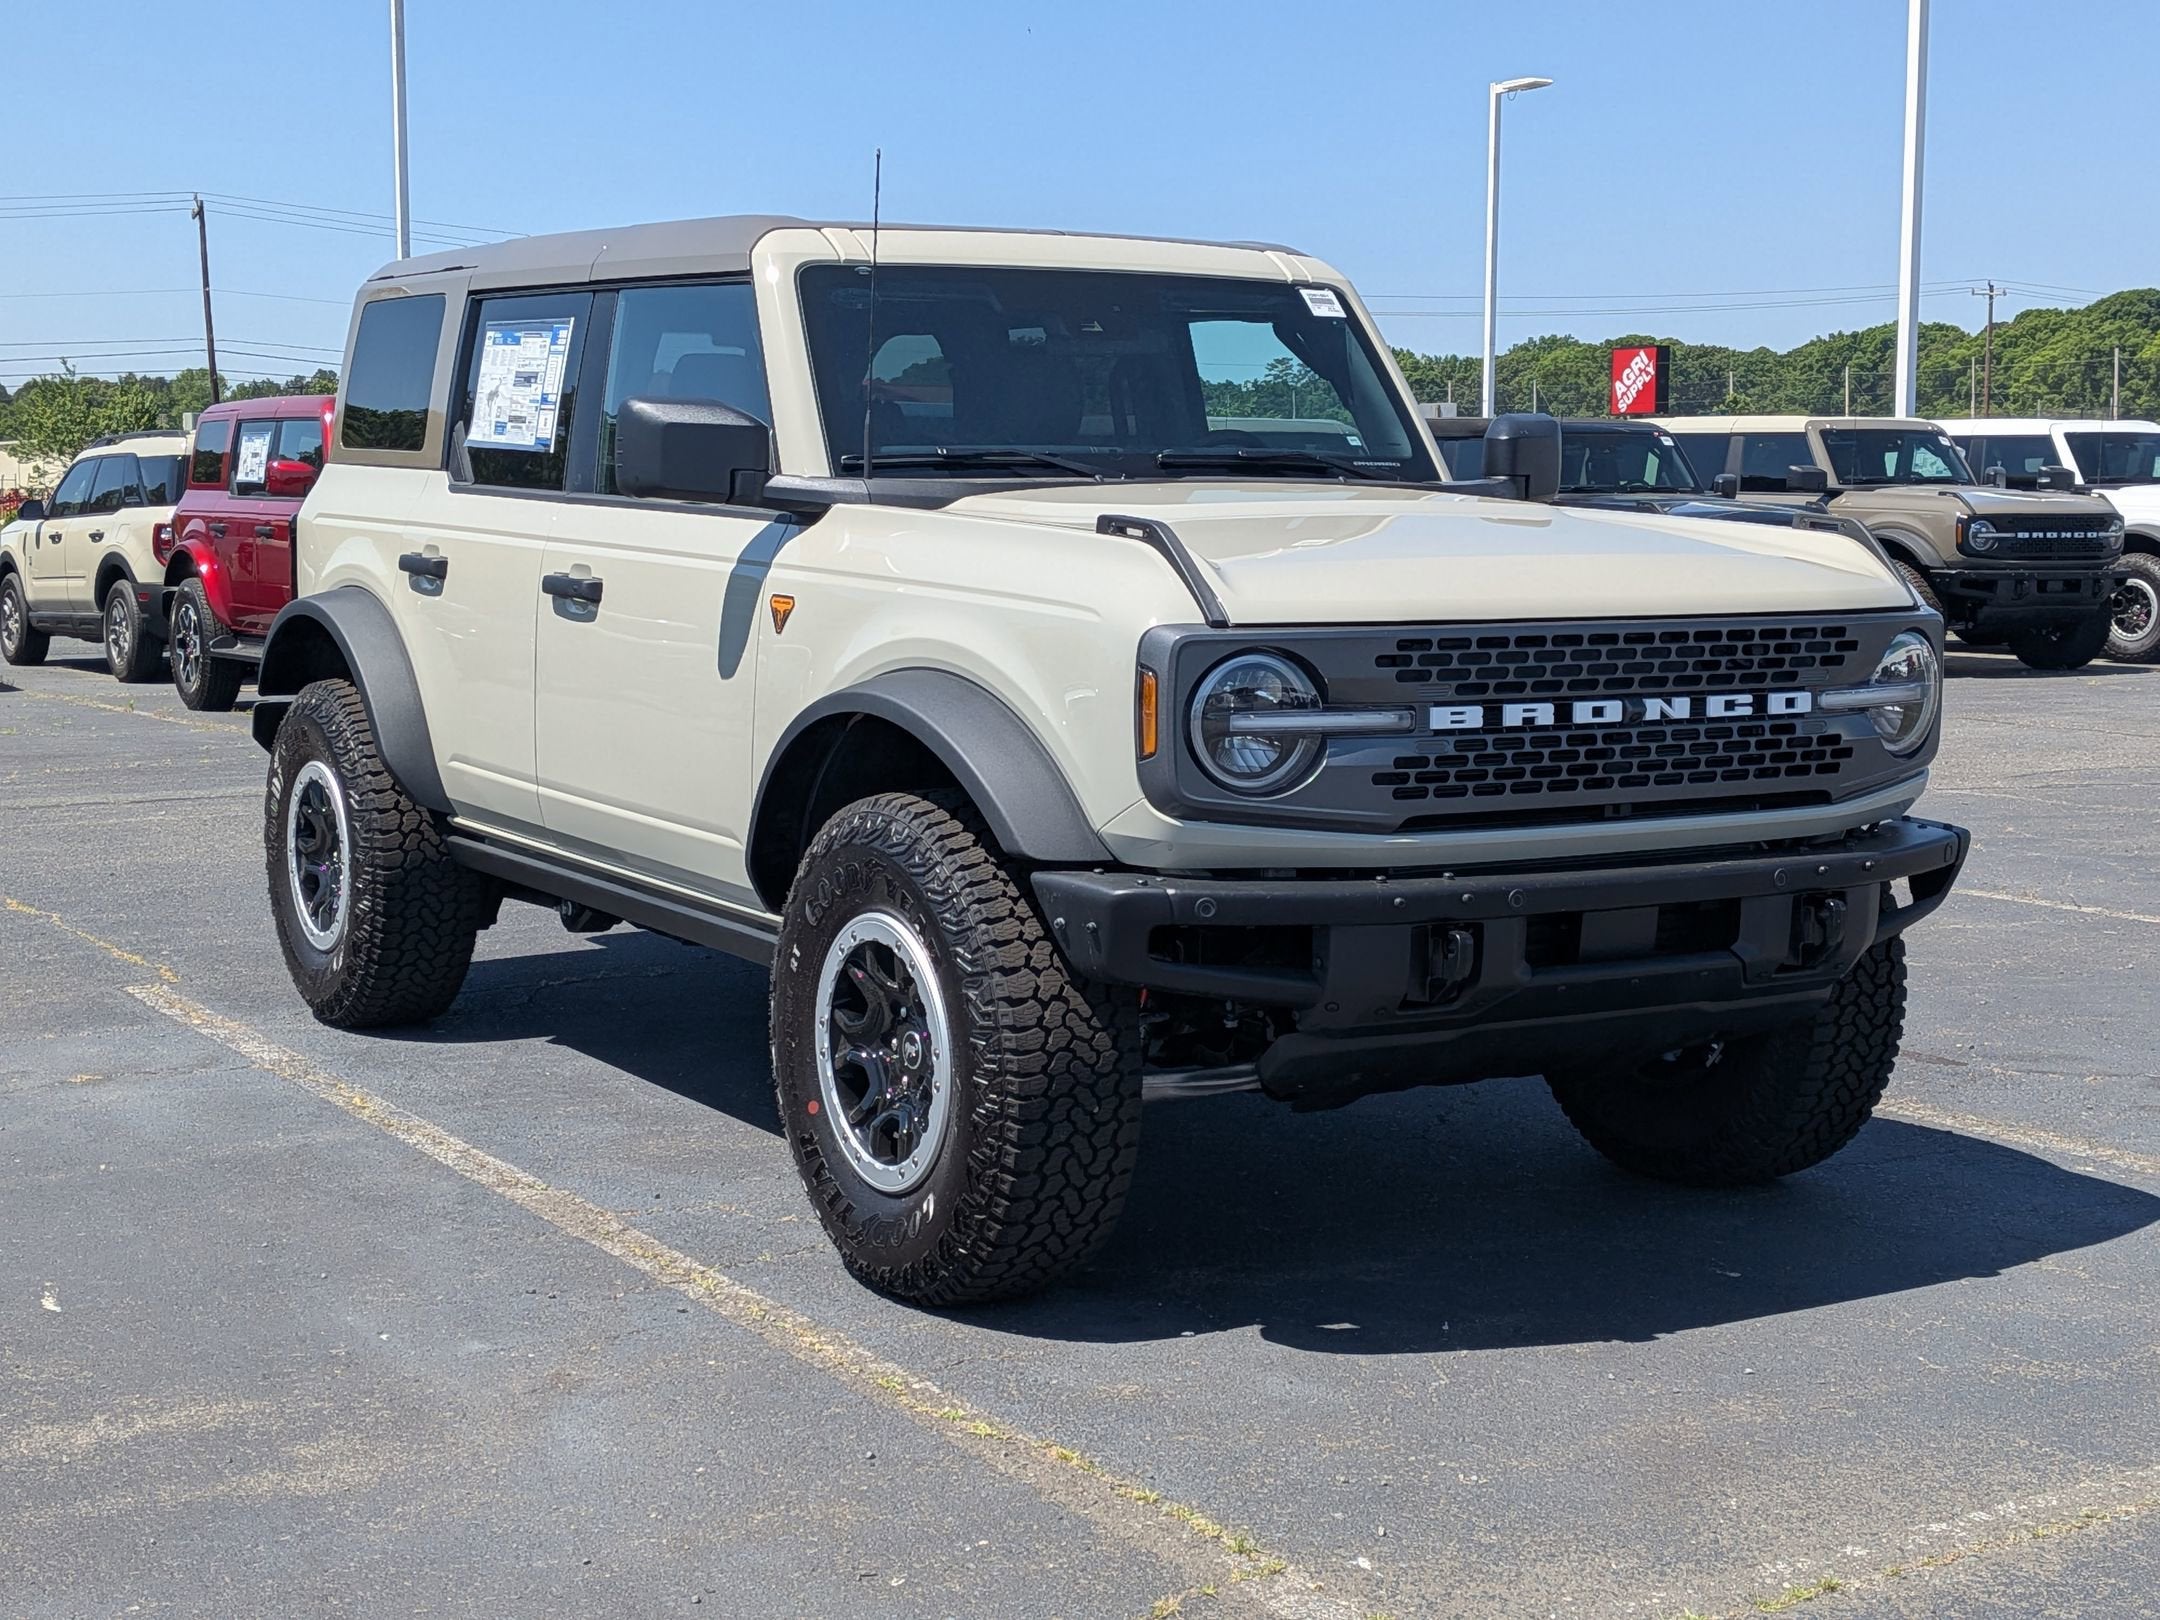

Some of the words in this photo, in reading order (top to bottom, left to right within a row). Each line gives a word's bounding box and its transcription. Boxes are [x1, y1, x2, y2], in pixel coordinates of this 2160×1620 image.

[1615, 350, 1649, 400] AGRI
[1618, 360, 1655, 413] SUPPLY
[1430, 691, 1812, 730] BRONCO
[799, 1130, 936, 1248] GOODYEAR
